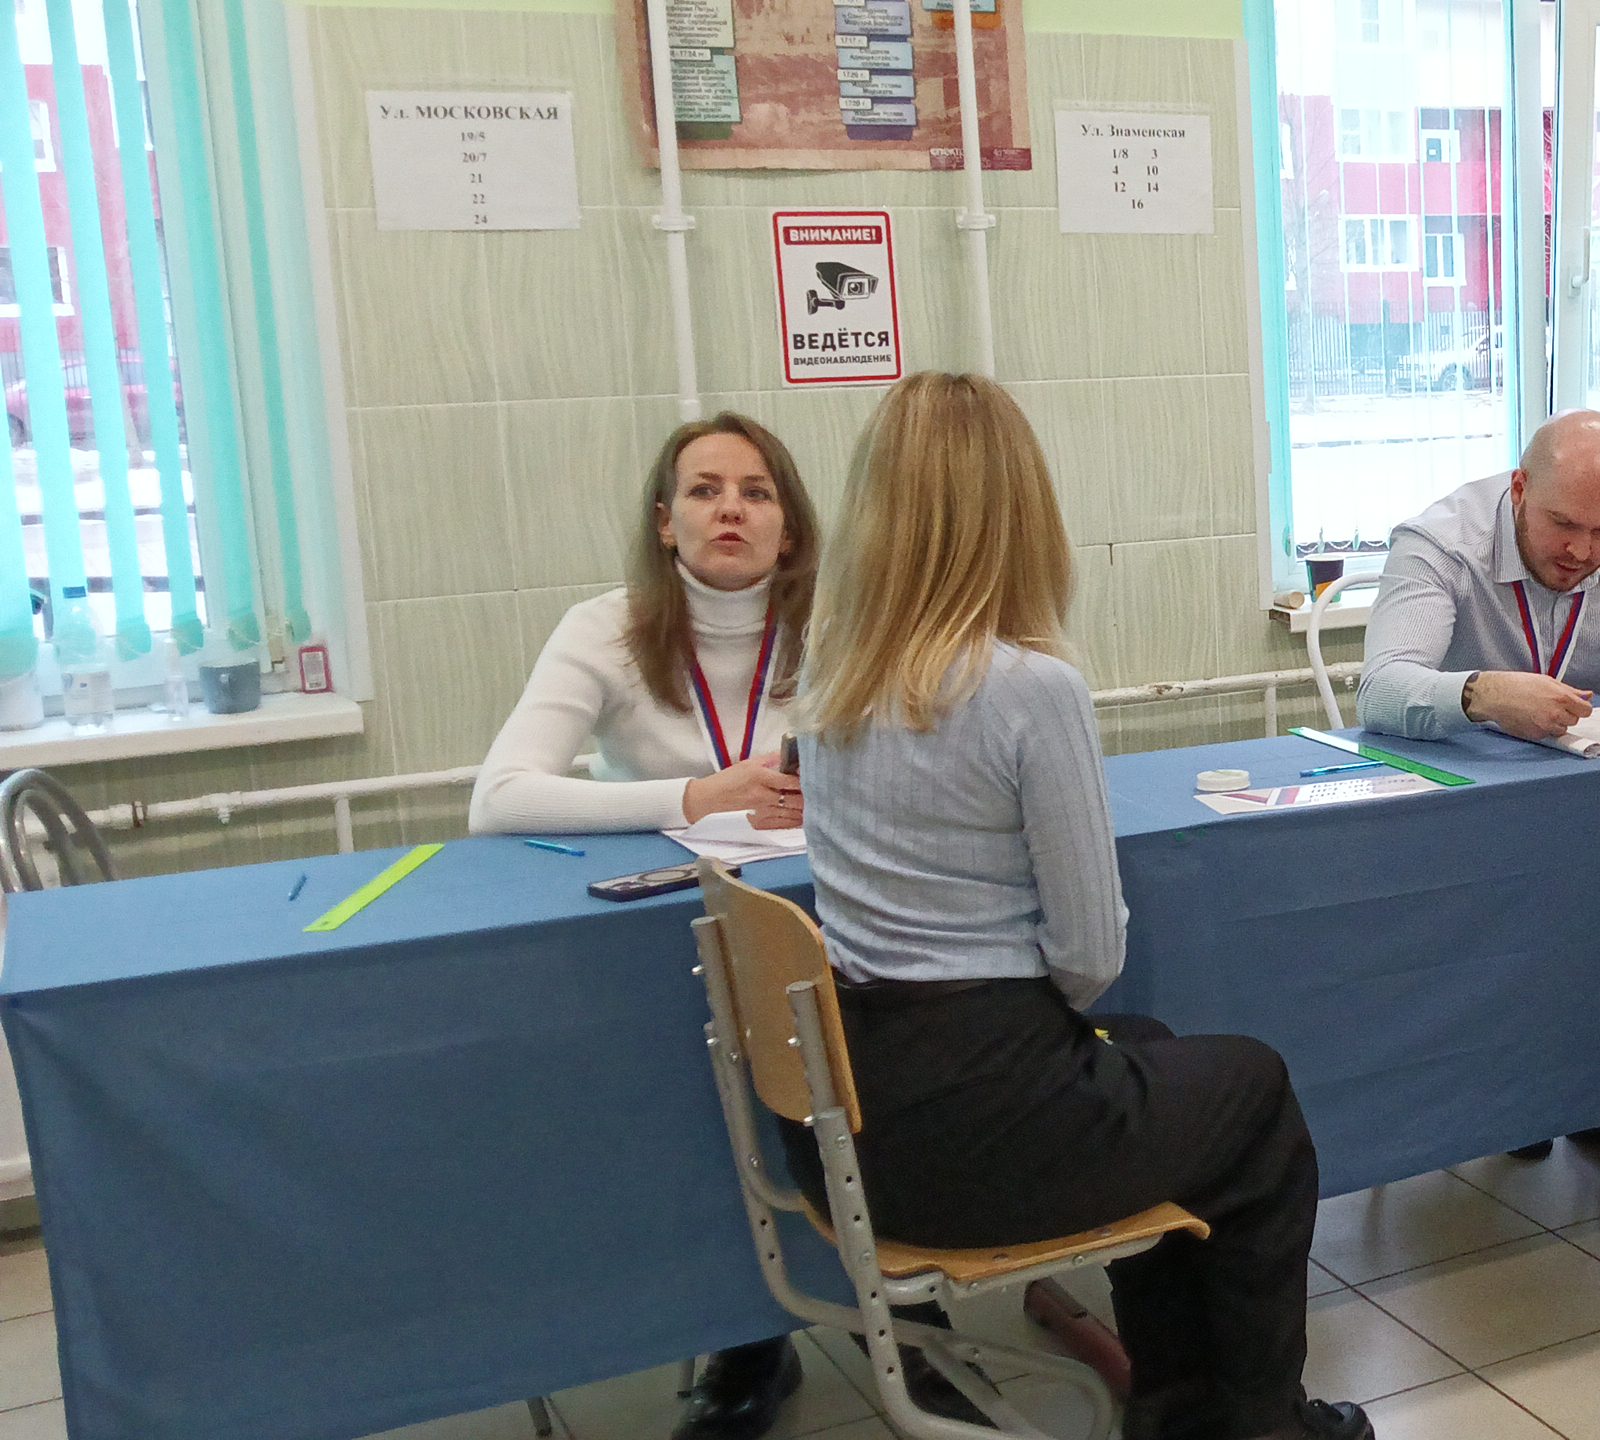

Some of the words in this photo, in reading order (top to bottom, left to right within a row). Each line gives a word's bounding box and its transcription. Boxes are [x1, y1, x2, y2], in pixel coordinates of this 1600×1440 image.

[380, 105, 409, 119] Ул.
[416, 105, 559, 120] МОСКОВСКАЯ
[1081, 124, 1103, 137] Ул.
[1109, 125, 1186, 138] Знаменская
[461, 132, 486, 142] 19/5
[462, 153, 487, 163] 20/7
[1112, 149, 1129, 159] 1/8
[1152, 149, 1158, 159] 3
[1112, 165, 1119, 175] 4
[1147, 165, 1159, 176] 10
[470, 173, 483, 183] 21
[1114, 182, 1126, 192] 12
[1147, 182, 1159, 192] 14
[473, 194, 486, 204] 22
[1131, 199, 1144, 209] 16
[474, 214, 488, 224] 24
[789, 228, 877, 242] ВНИМАНИЕ!
[792, 328, 890, 352] ВЕДЁТСЯ
[793, 354, 892, 366] ВИДЕОНАБЛЮДЕНИЕ
